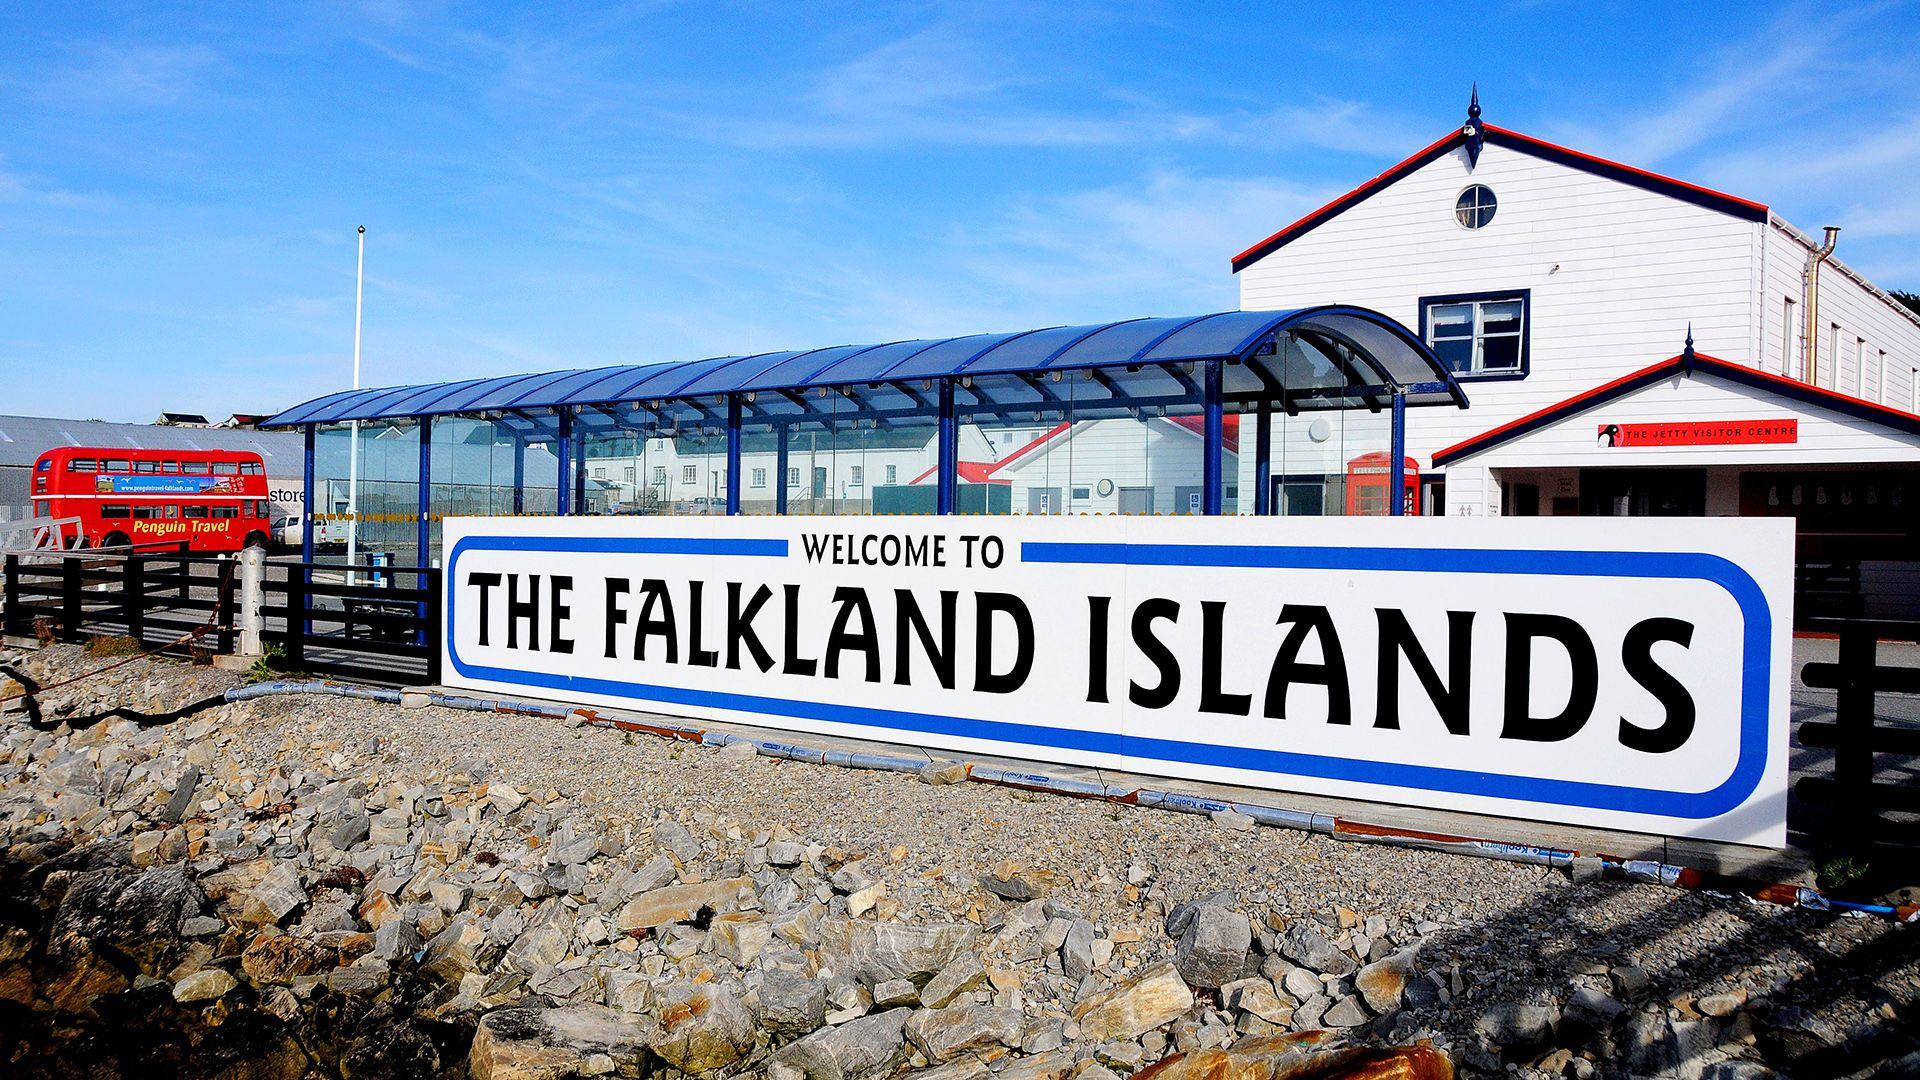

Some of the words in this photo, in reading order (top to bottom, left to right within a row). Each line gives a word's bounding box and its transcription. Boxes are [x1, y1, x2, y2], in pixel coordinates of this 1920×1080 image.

[1627, 431, 1647, 439] THE
[1653, 429, 1687, 438] JETTY
[1694, 428, 1742, 437] VISITOR
[1748, 427, 1795, 436] CENTRE
[133, 520, 186, 536] Penguin
[191, 519, 230, 532] Travel
[802, 534, 945, 567] WELCOME
[960, 536, 1003, 568] TO
[468, 573, 574, 651] THE
[604, 578, 1034, 693] FALKLAND
[1086, 596, 1695, 753] ISLANDS
